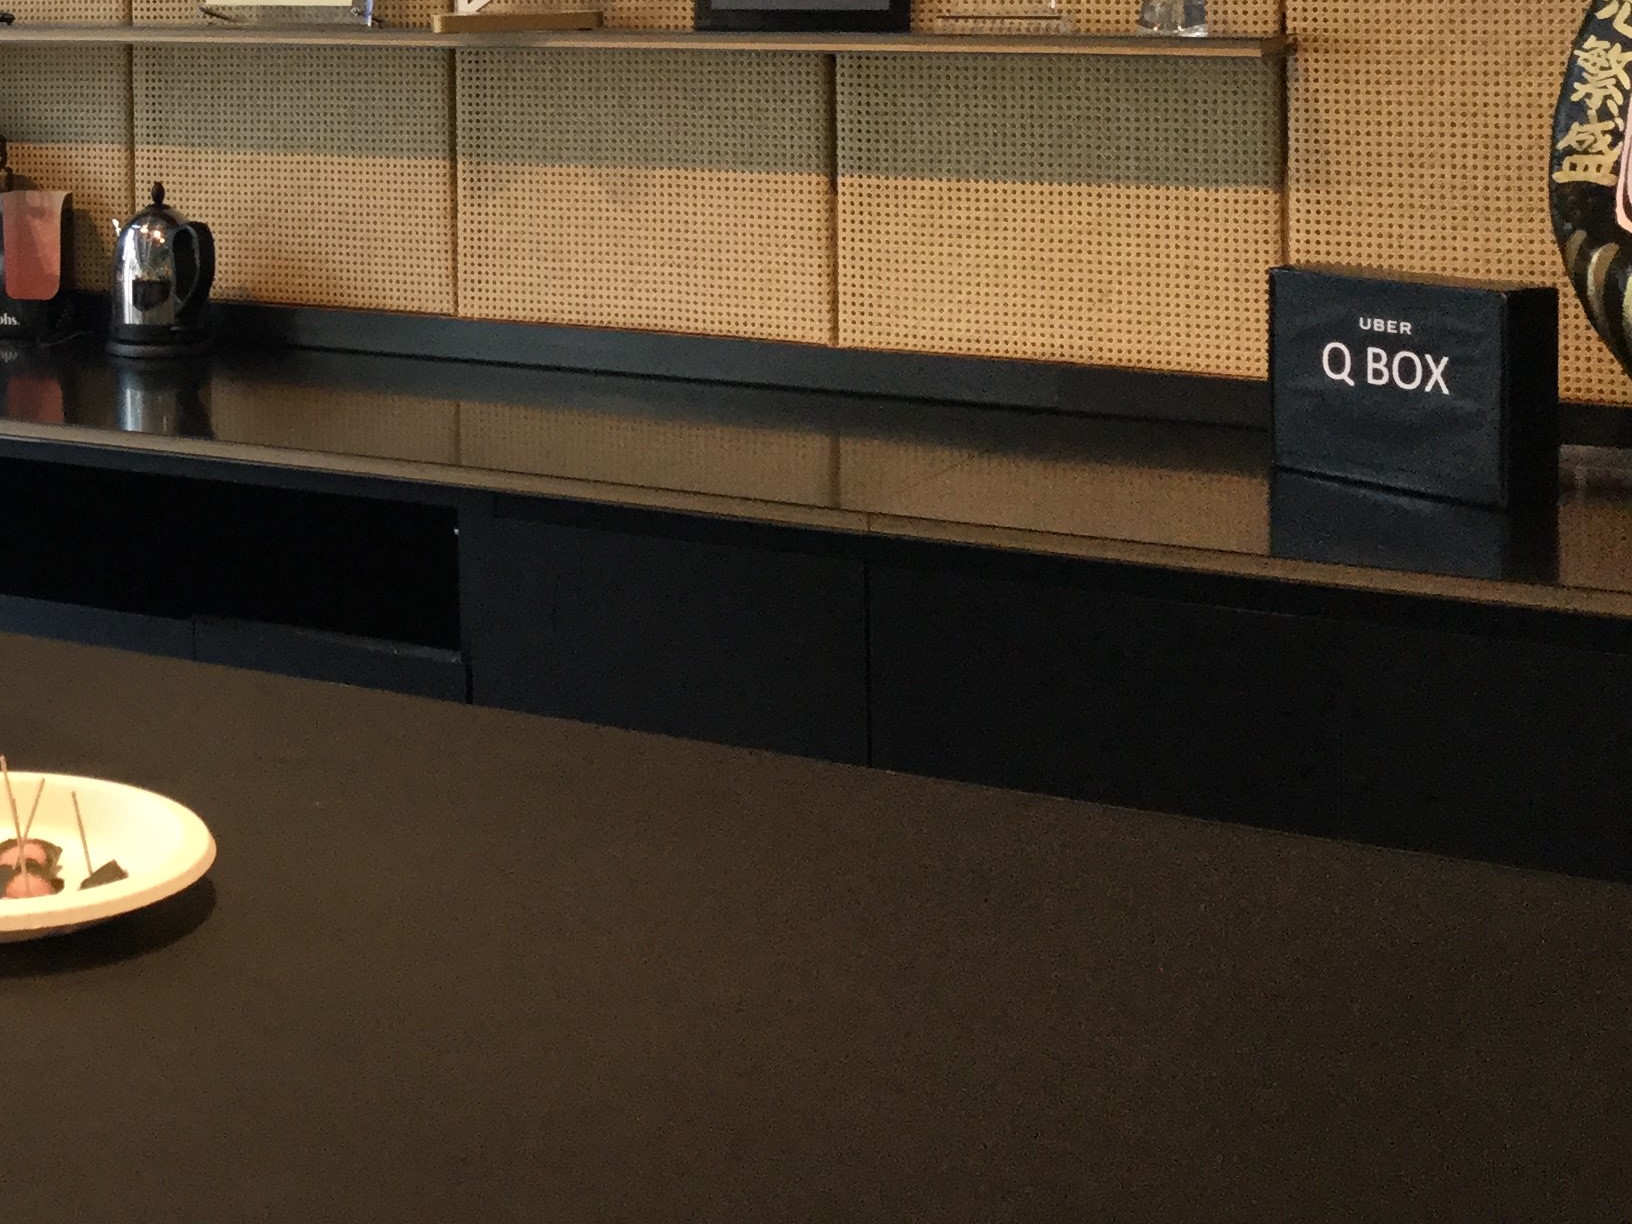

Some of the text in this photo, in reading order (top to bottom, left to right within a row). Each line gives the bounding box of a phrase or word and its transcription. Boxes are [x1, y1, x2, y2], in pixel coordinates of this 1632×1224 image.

[1359, 317, 1413, 336] UBER
[1321, 341, 1450, 396] Q BOX
